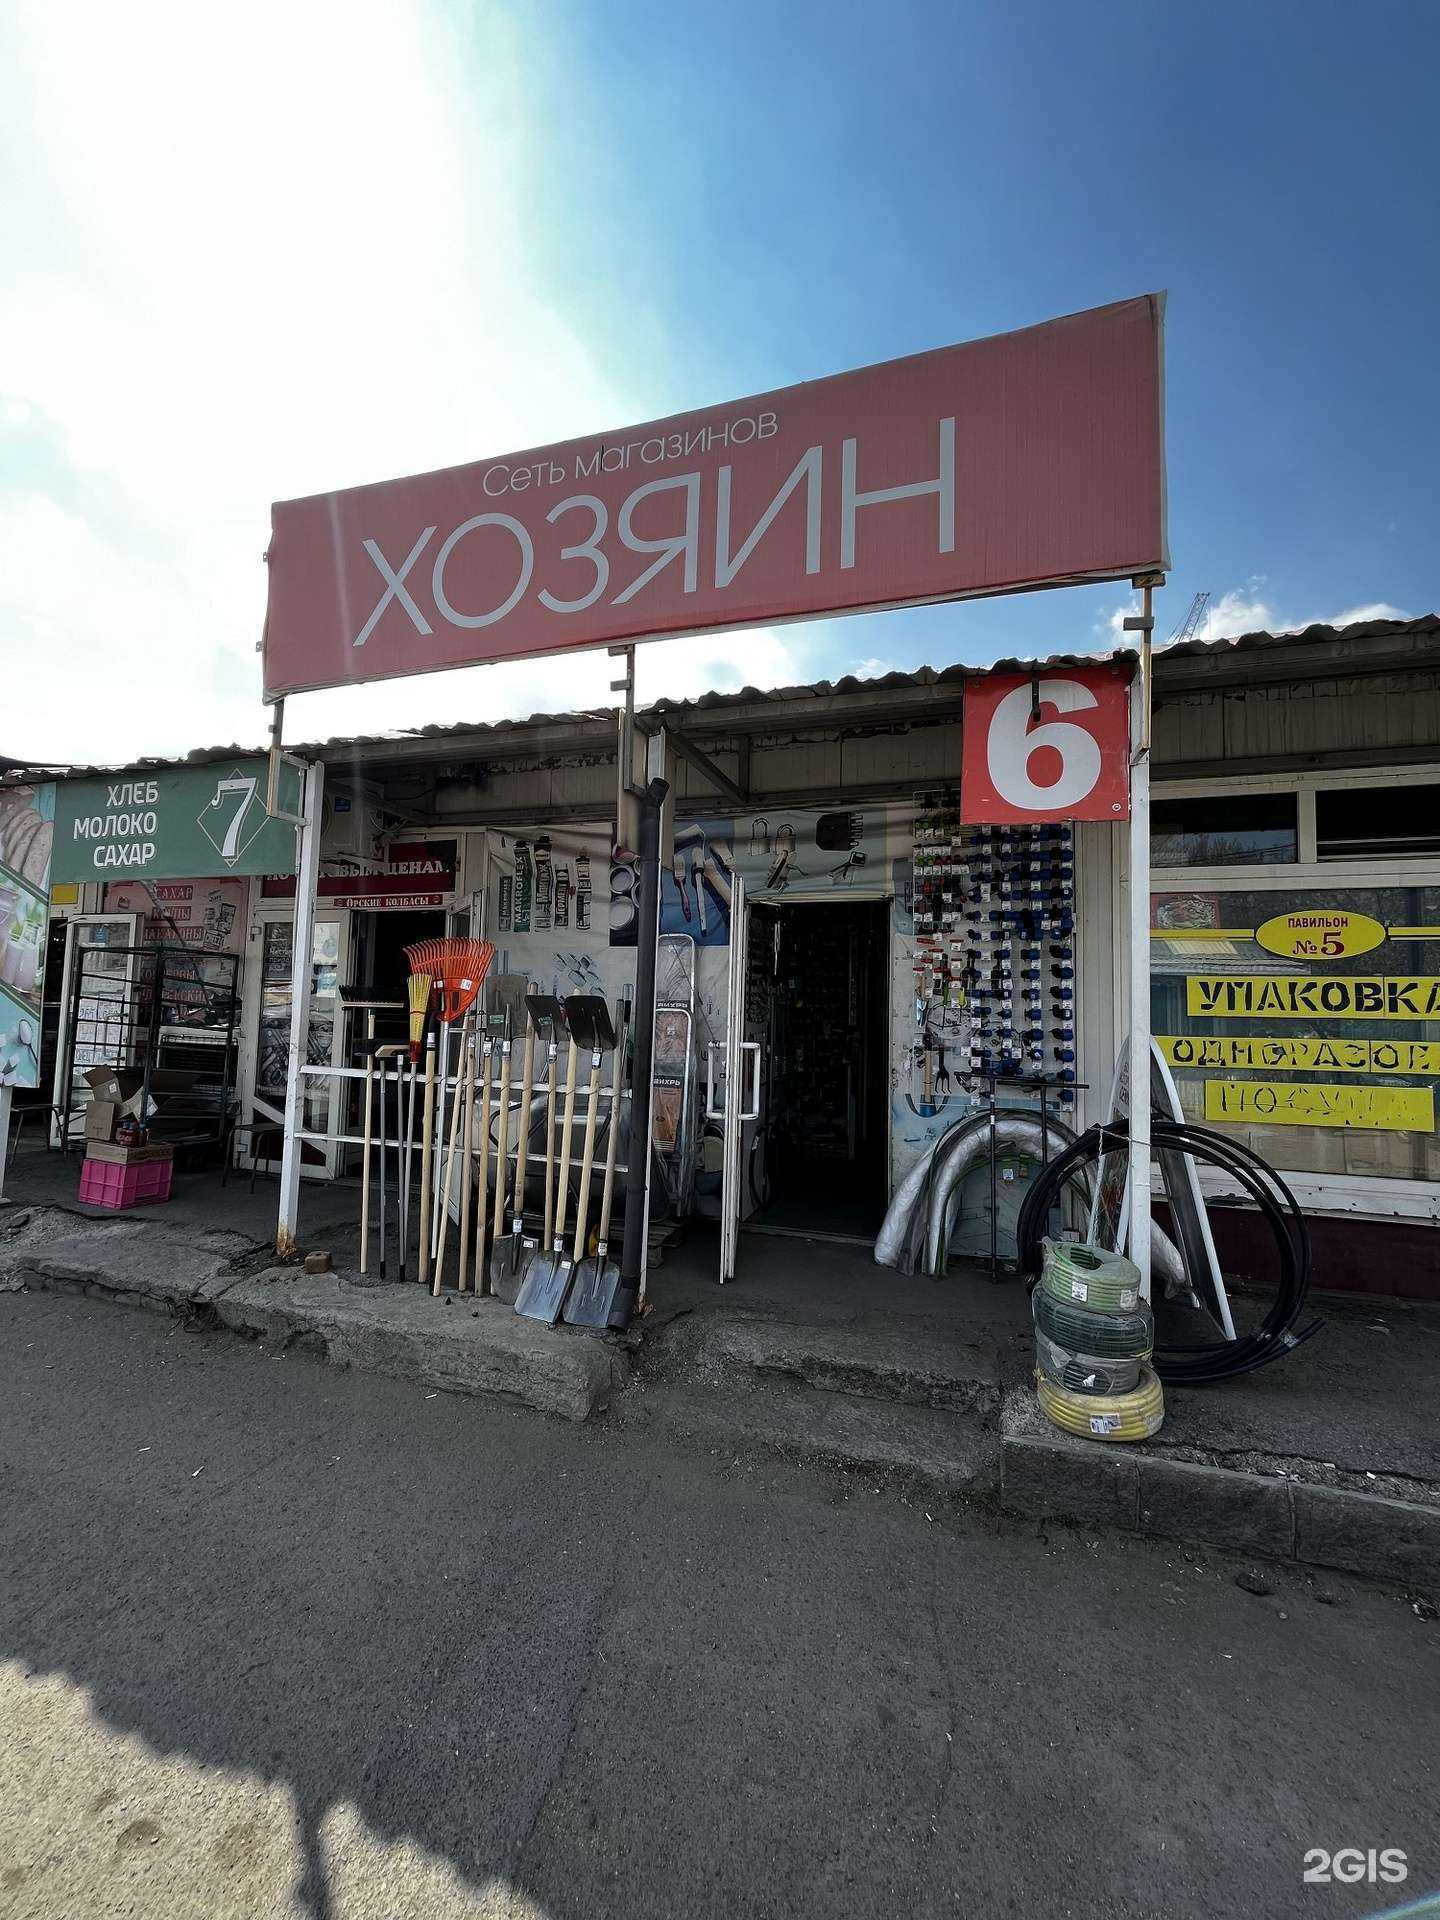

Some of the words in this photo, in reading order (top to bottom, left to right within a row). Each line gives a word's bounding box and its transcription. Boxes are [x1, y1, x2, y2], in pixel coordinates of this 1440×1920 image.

[483, 465, 566, 497] Сеть
[575, 412, 778, 480] магазинов
[352, 415, 956, 648] ХОЗЯИН
[987, 679, 1102, 810] 6
[73, 812, 157, 840] МОЛОКО
[106, 781, 158, 807] ХЛЕБ
[212, 777, 257, 857] 7
[93, 843, 156, 868] САХАР
[514, 856, 524, 923] MAKROFLEX
[1288, 917, 1348, 929] ПАВИЛЬОН
